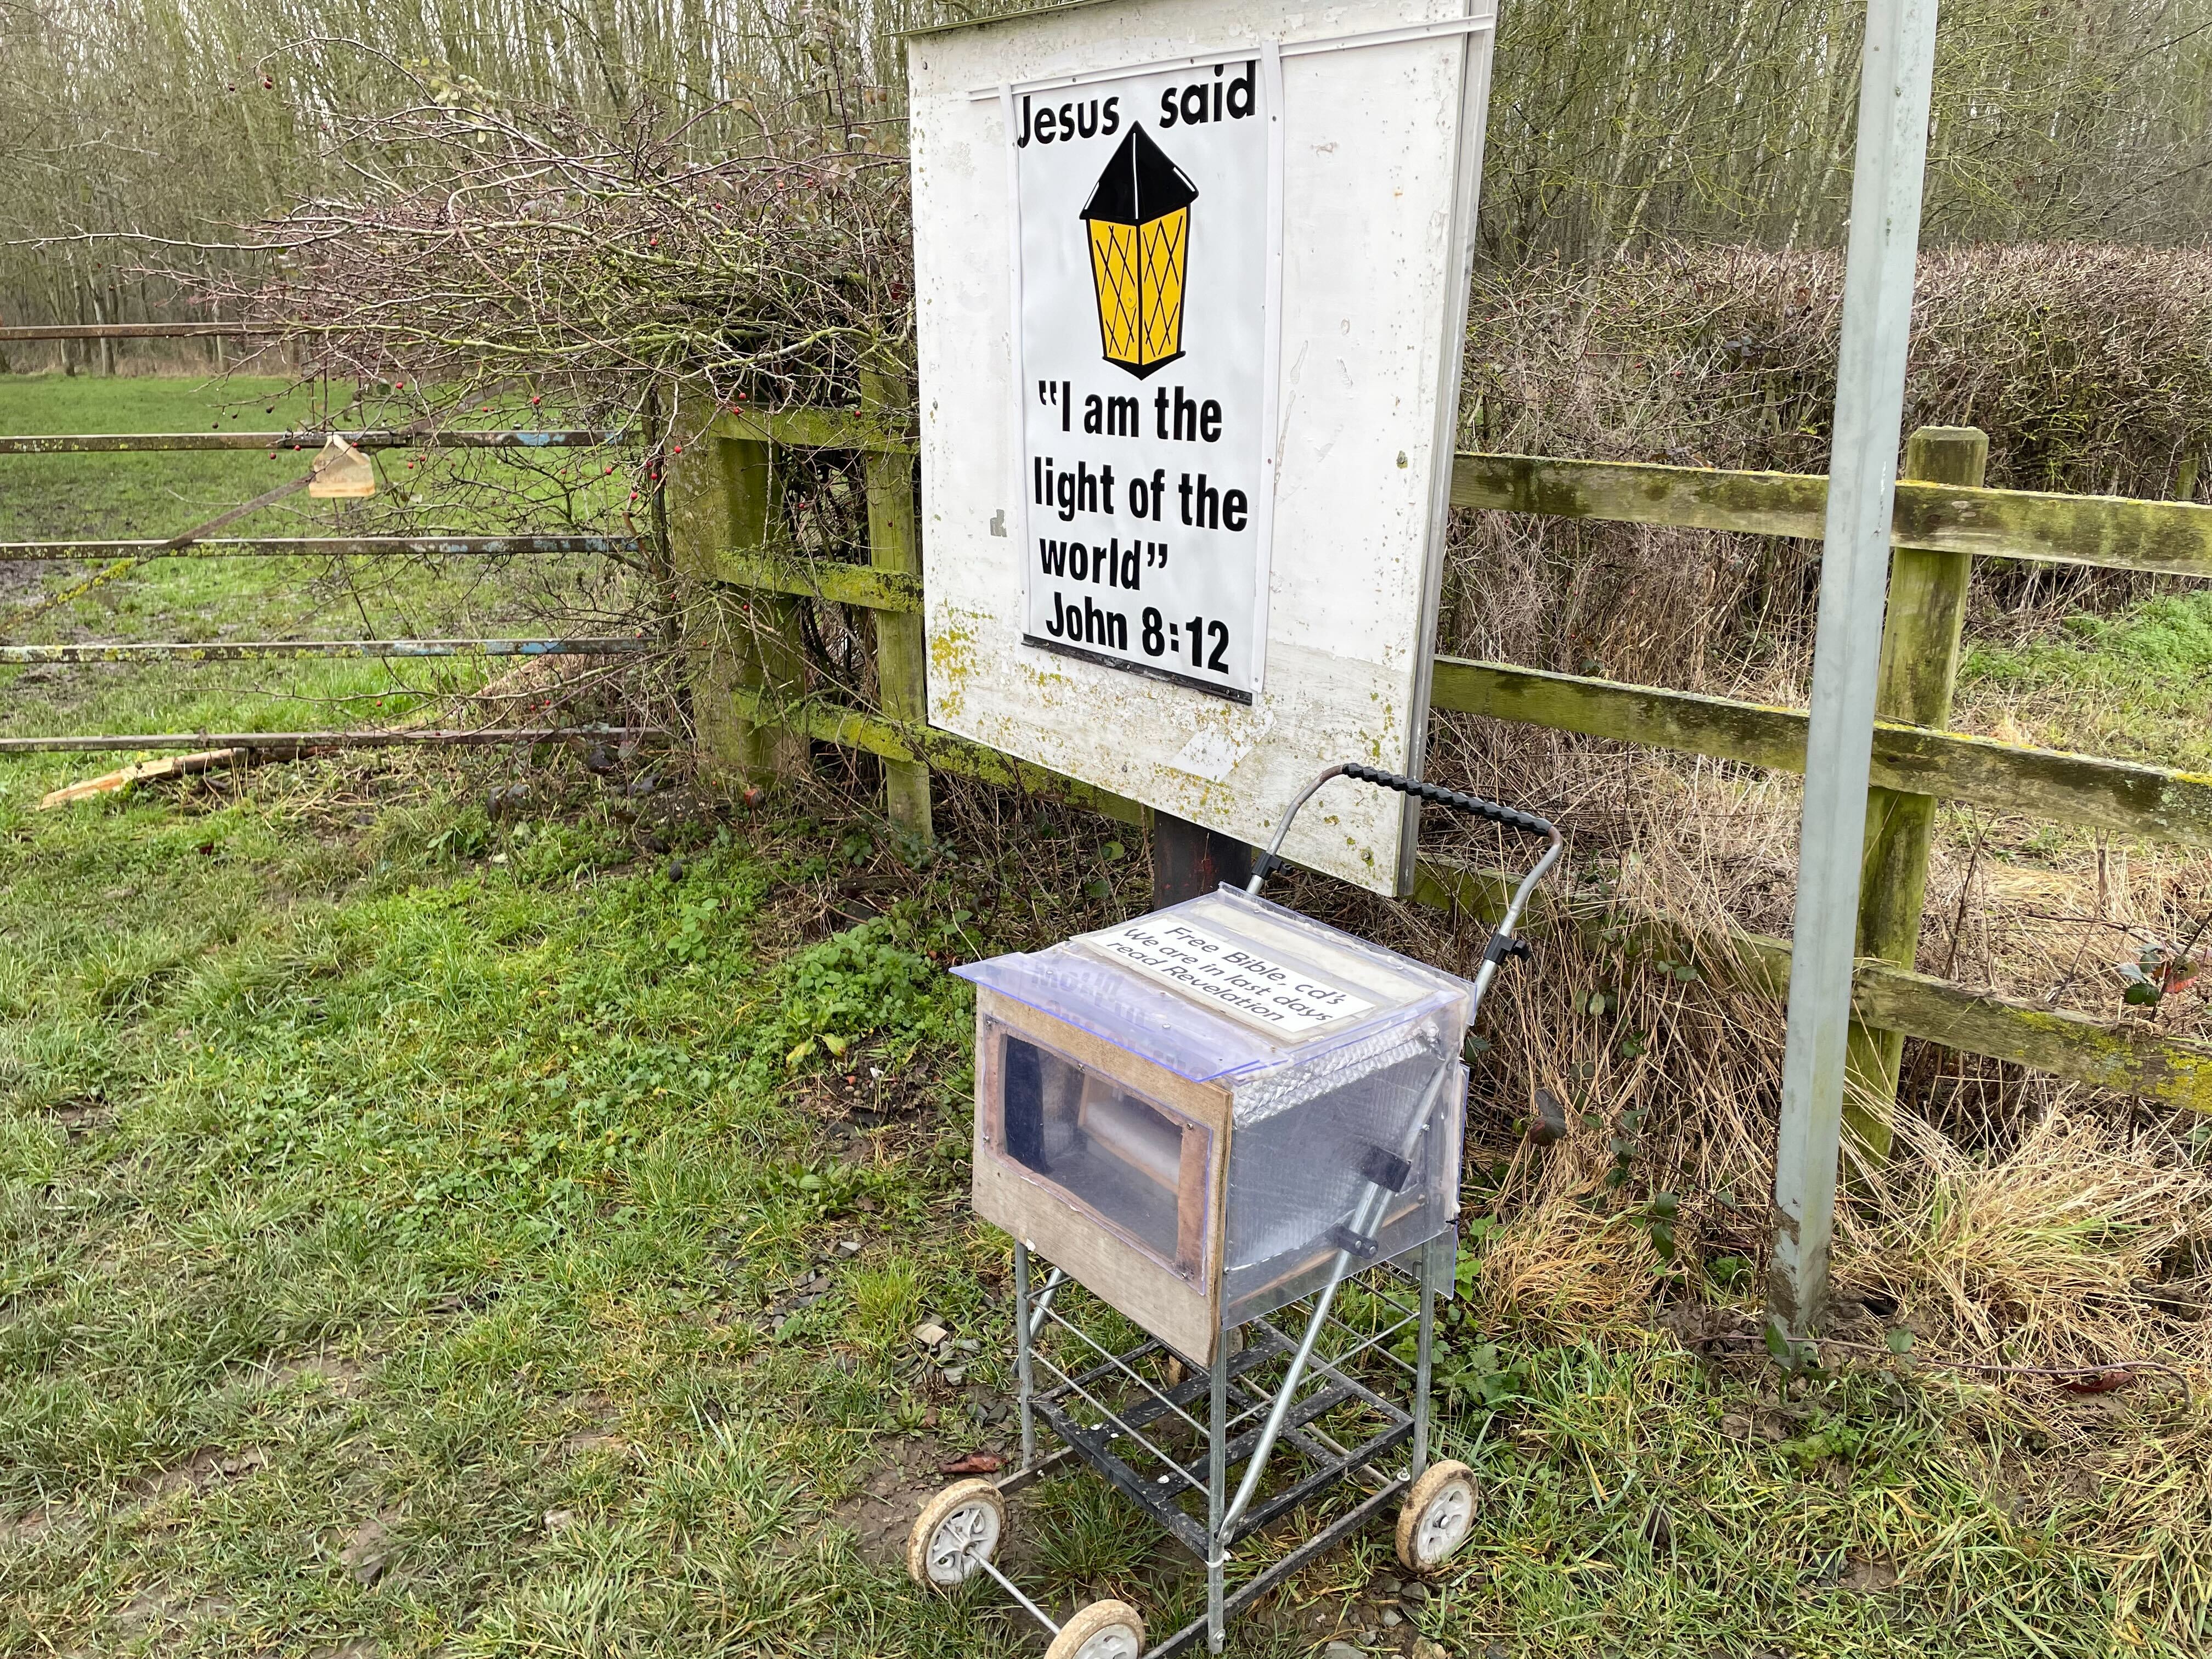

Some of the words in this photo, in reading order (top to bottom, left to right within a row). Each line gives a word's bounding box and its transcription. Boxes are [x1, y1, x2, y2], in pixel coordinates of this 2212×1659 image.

[1017, 94, 1120, 149] Jesus
[1159, 59, 1257, 129] said
[1084, 393, 1139, 438] am
[1154, 385, 1222, 443] the
[1034, 456, 1115, 522] light
[1128, 468, 1165, 522] of
[1178, 472, 1248, 532] the
[1045, 591, 1128, 651] John
[1141, 606, 1229, 675] 8:12
[1105, 942, 1169, 966] read
[1160, 965, 1285, 1022] Revelation
[1123, 928, 1160, 947] We
[1158, 947, 1199, 964] are
[1198, 963, 1226, 977] in
[1223, 974, 1272, 996] last
[1272, 996, 1334, 1021] days
[1163, 927, 1220, 953] Free
[1221, 951, 1287, 986] Bible,
